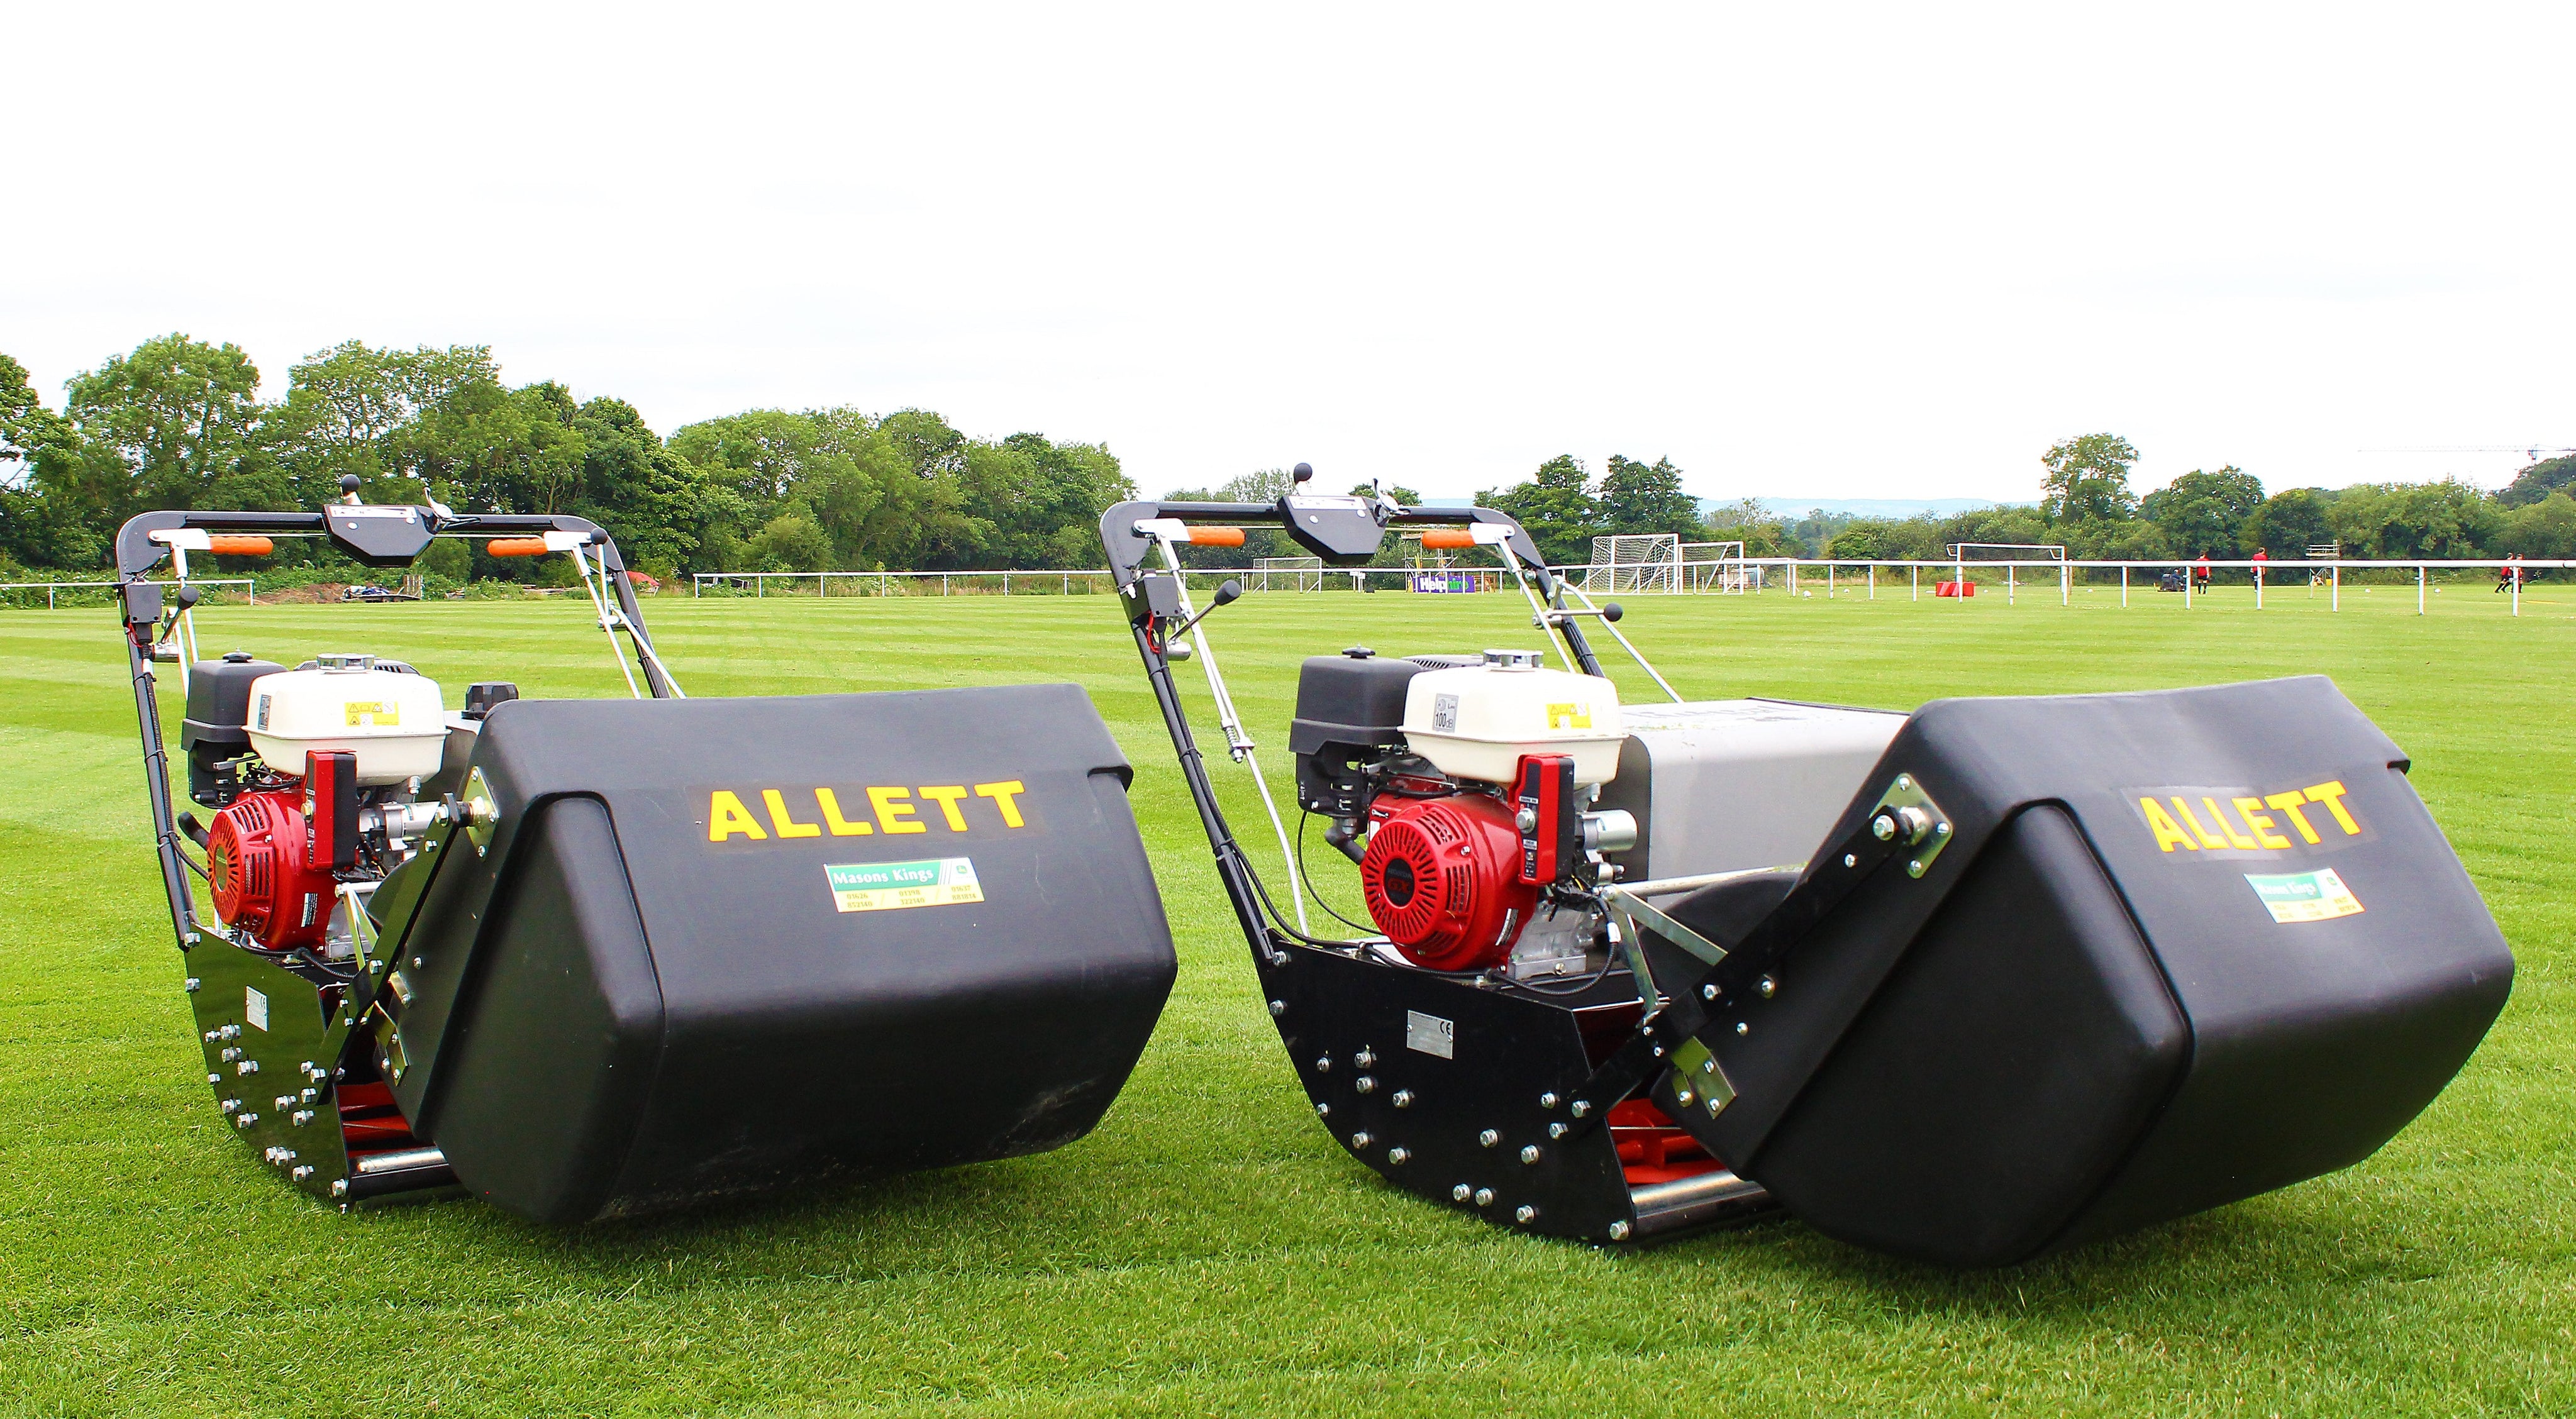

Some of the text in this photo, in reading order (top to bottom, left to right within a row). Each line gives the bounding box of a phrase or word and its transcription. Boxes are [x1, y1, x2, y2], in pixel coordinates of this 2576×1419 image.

[708, 780, 1026, 842] ALLETT
[2139, 780, 2362, 853] ALLETT
[833, 867, 934, 885] Masons Kings
